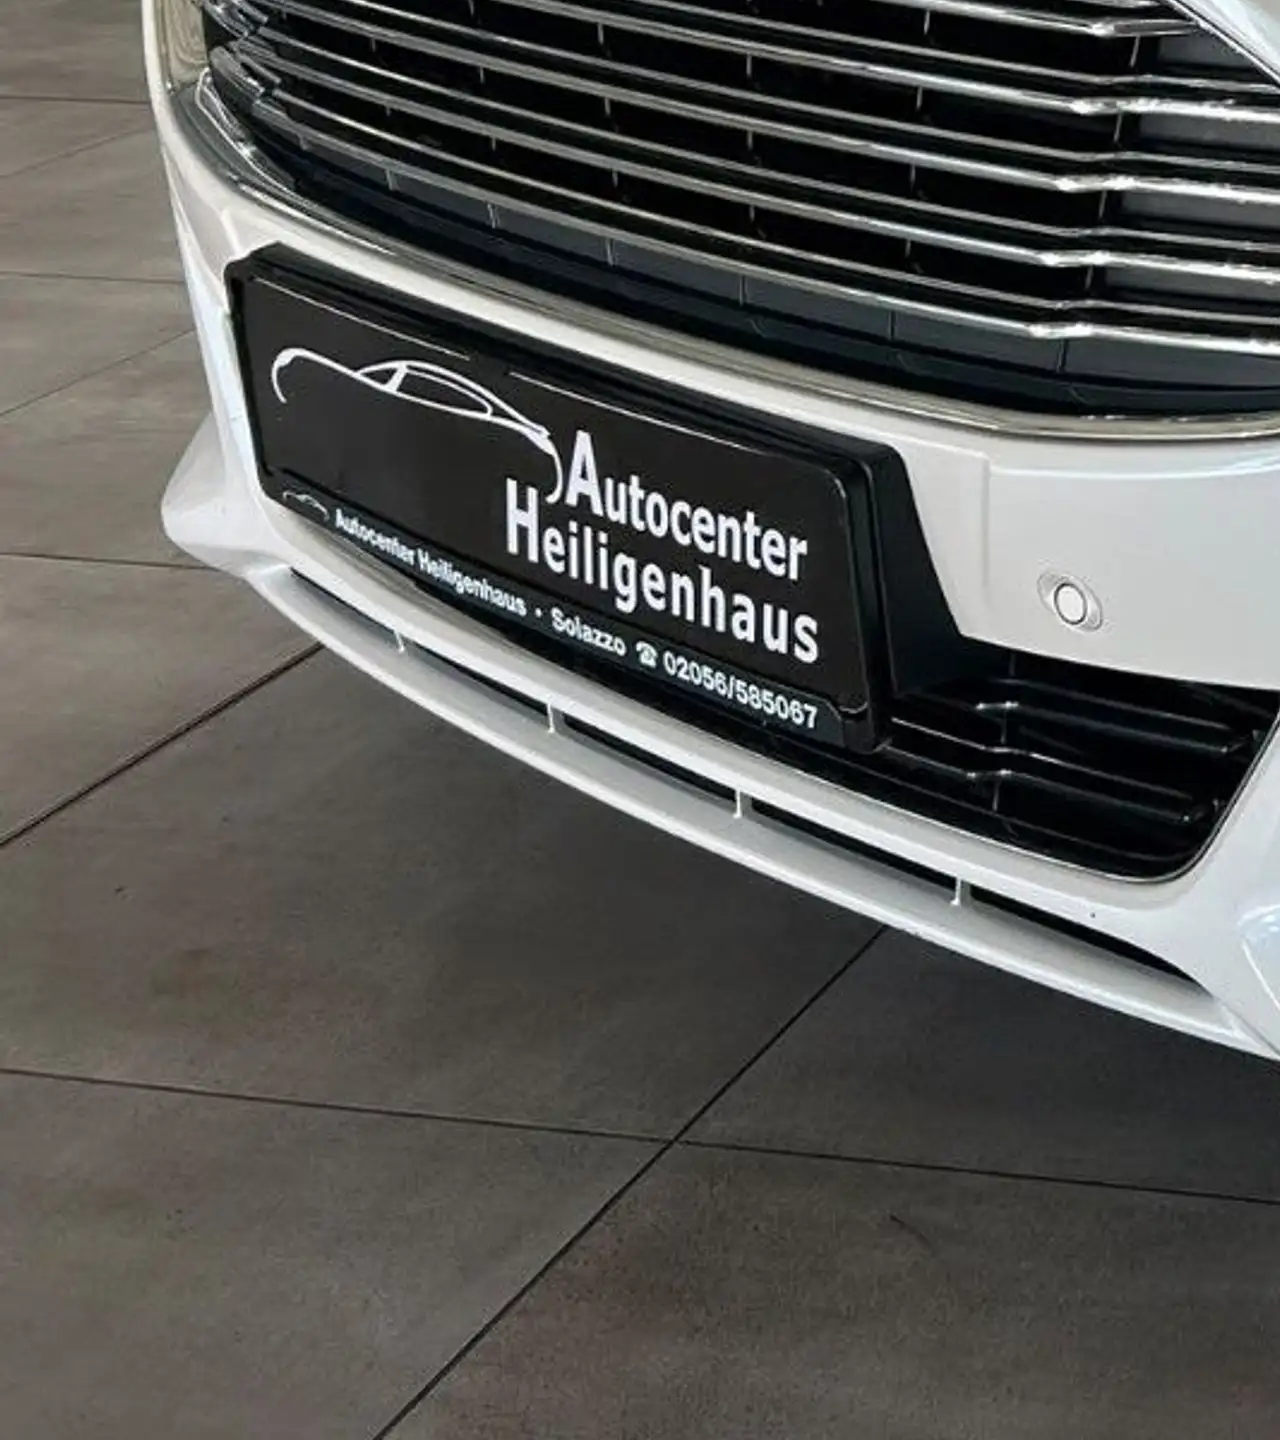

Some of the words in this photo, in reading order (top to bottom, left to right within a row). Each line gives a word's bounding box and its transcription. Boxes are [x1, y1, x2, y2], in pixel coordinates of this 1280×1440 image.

[505, 477, 819, 664] Heiligenhaus
[564, 429, 808, 581] Autocenter
[335, 508, 415, 564] Autocenter
[416, 548, 528, 618] Heiligenhaus
[550, 606, 627, 657] Solazzo
[662, 651, 819, 730] 02056/585067
